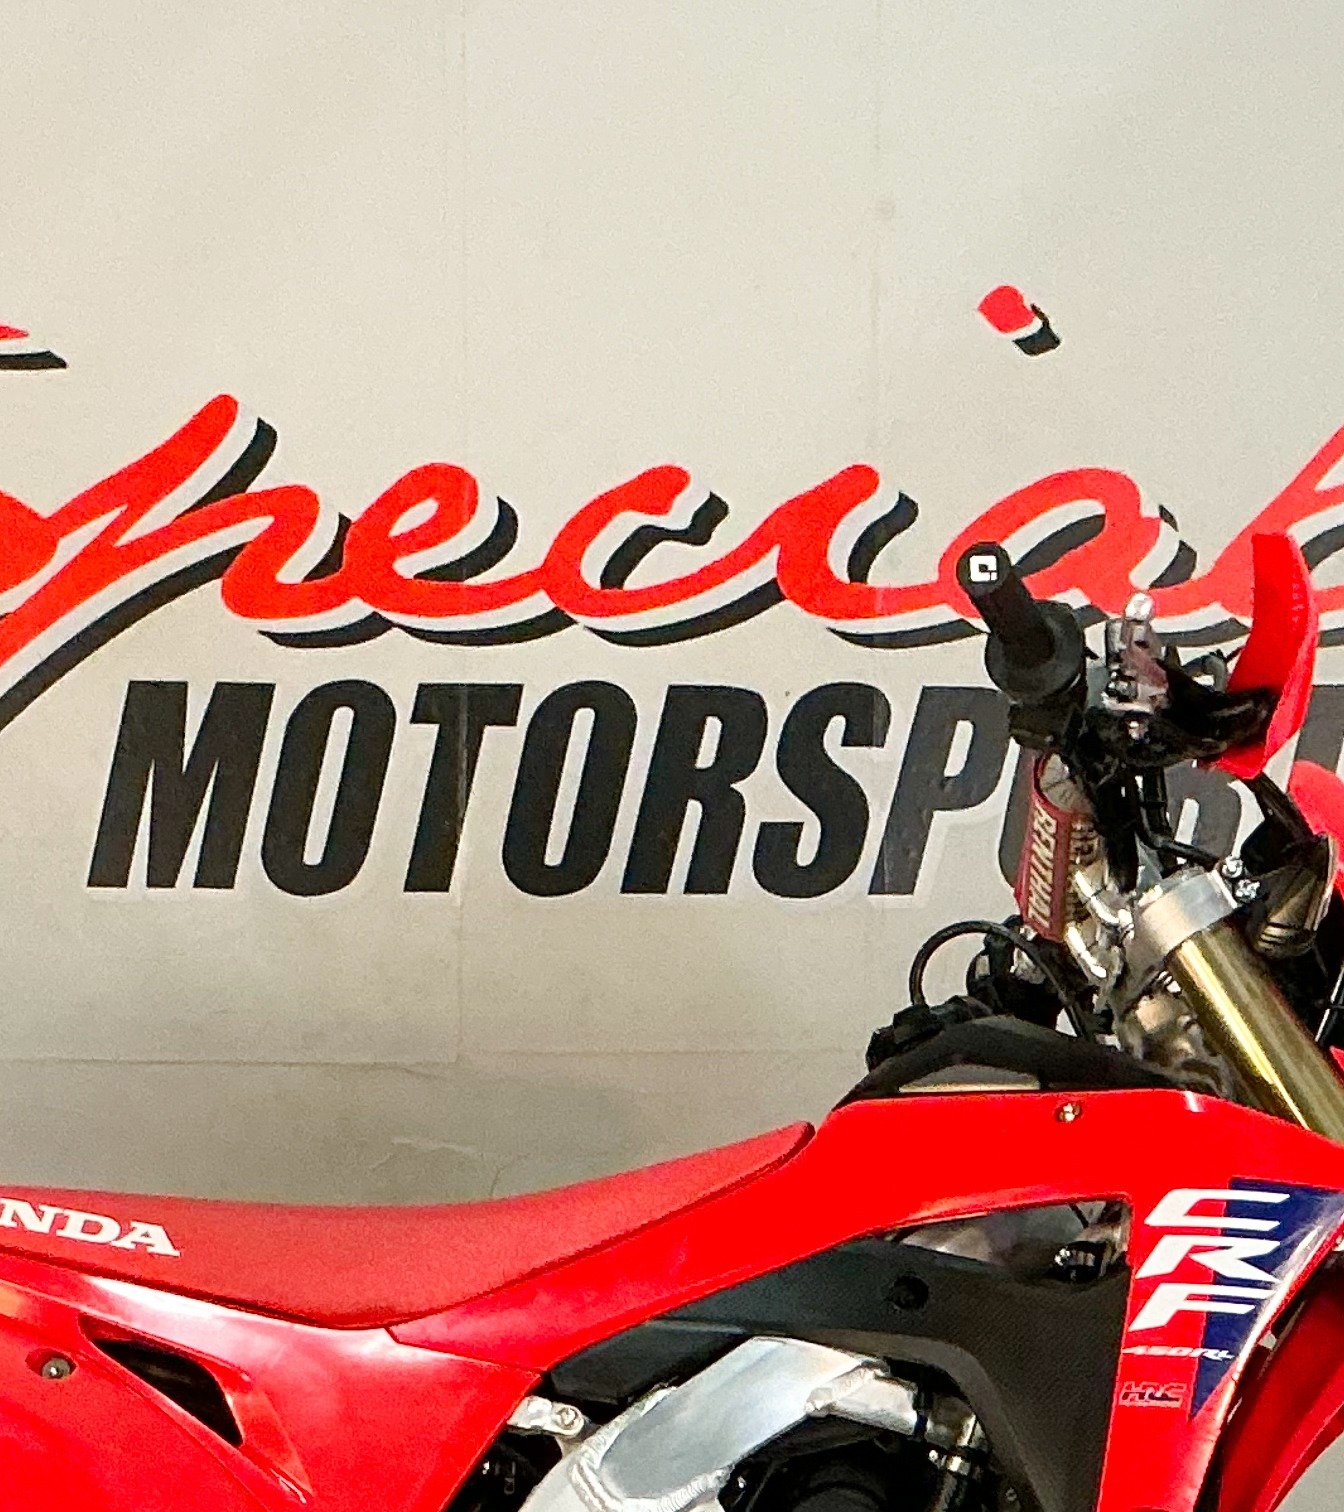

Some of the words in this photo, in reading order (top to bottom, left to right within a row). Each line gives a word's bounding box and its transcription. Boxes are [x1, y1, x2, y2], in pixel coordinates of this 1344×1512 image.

[1028, 799, 1057, 929] RENTHAL
[1128, 1188, 1290, 1332] CRF
[1119, 1381, 1187, 1407] HRC
